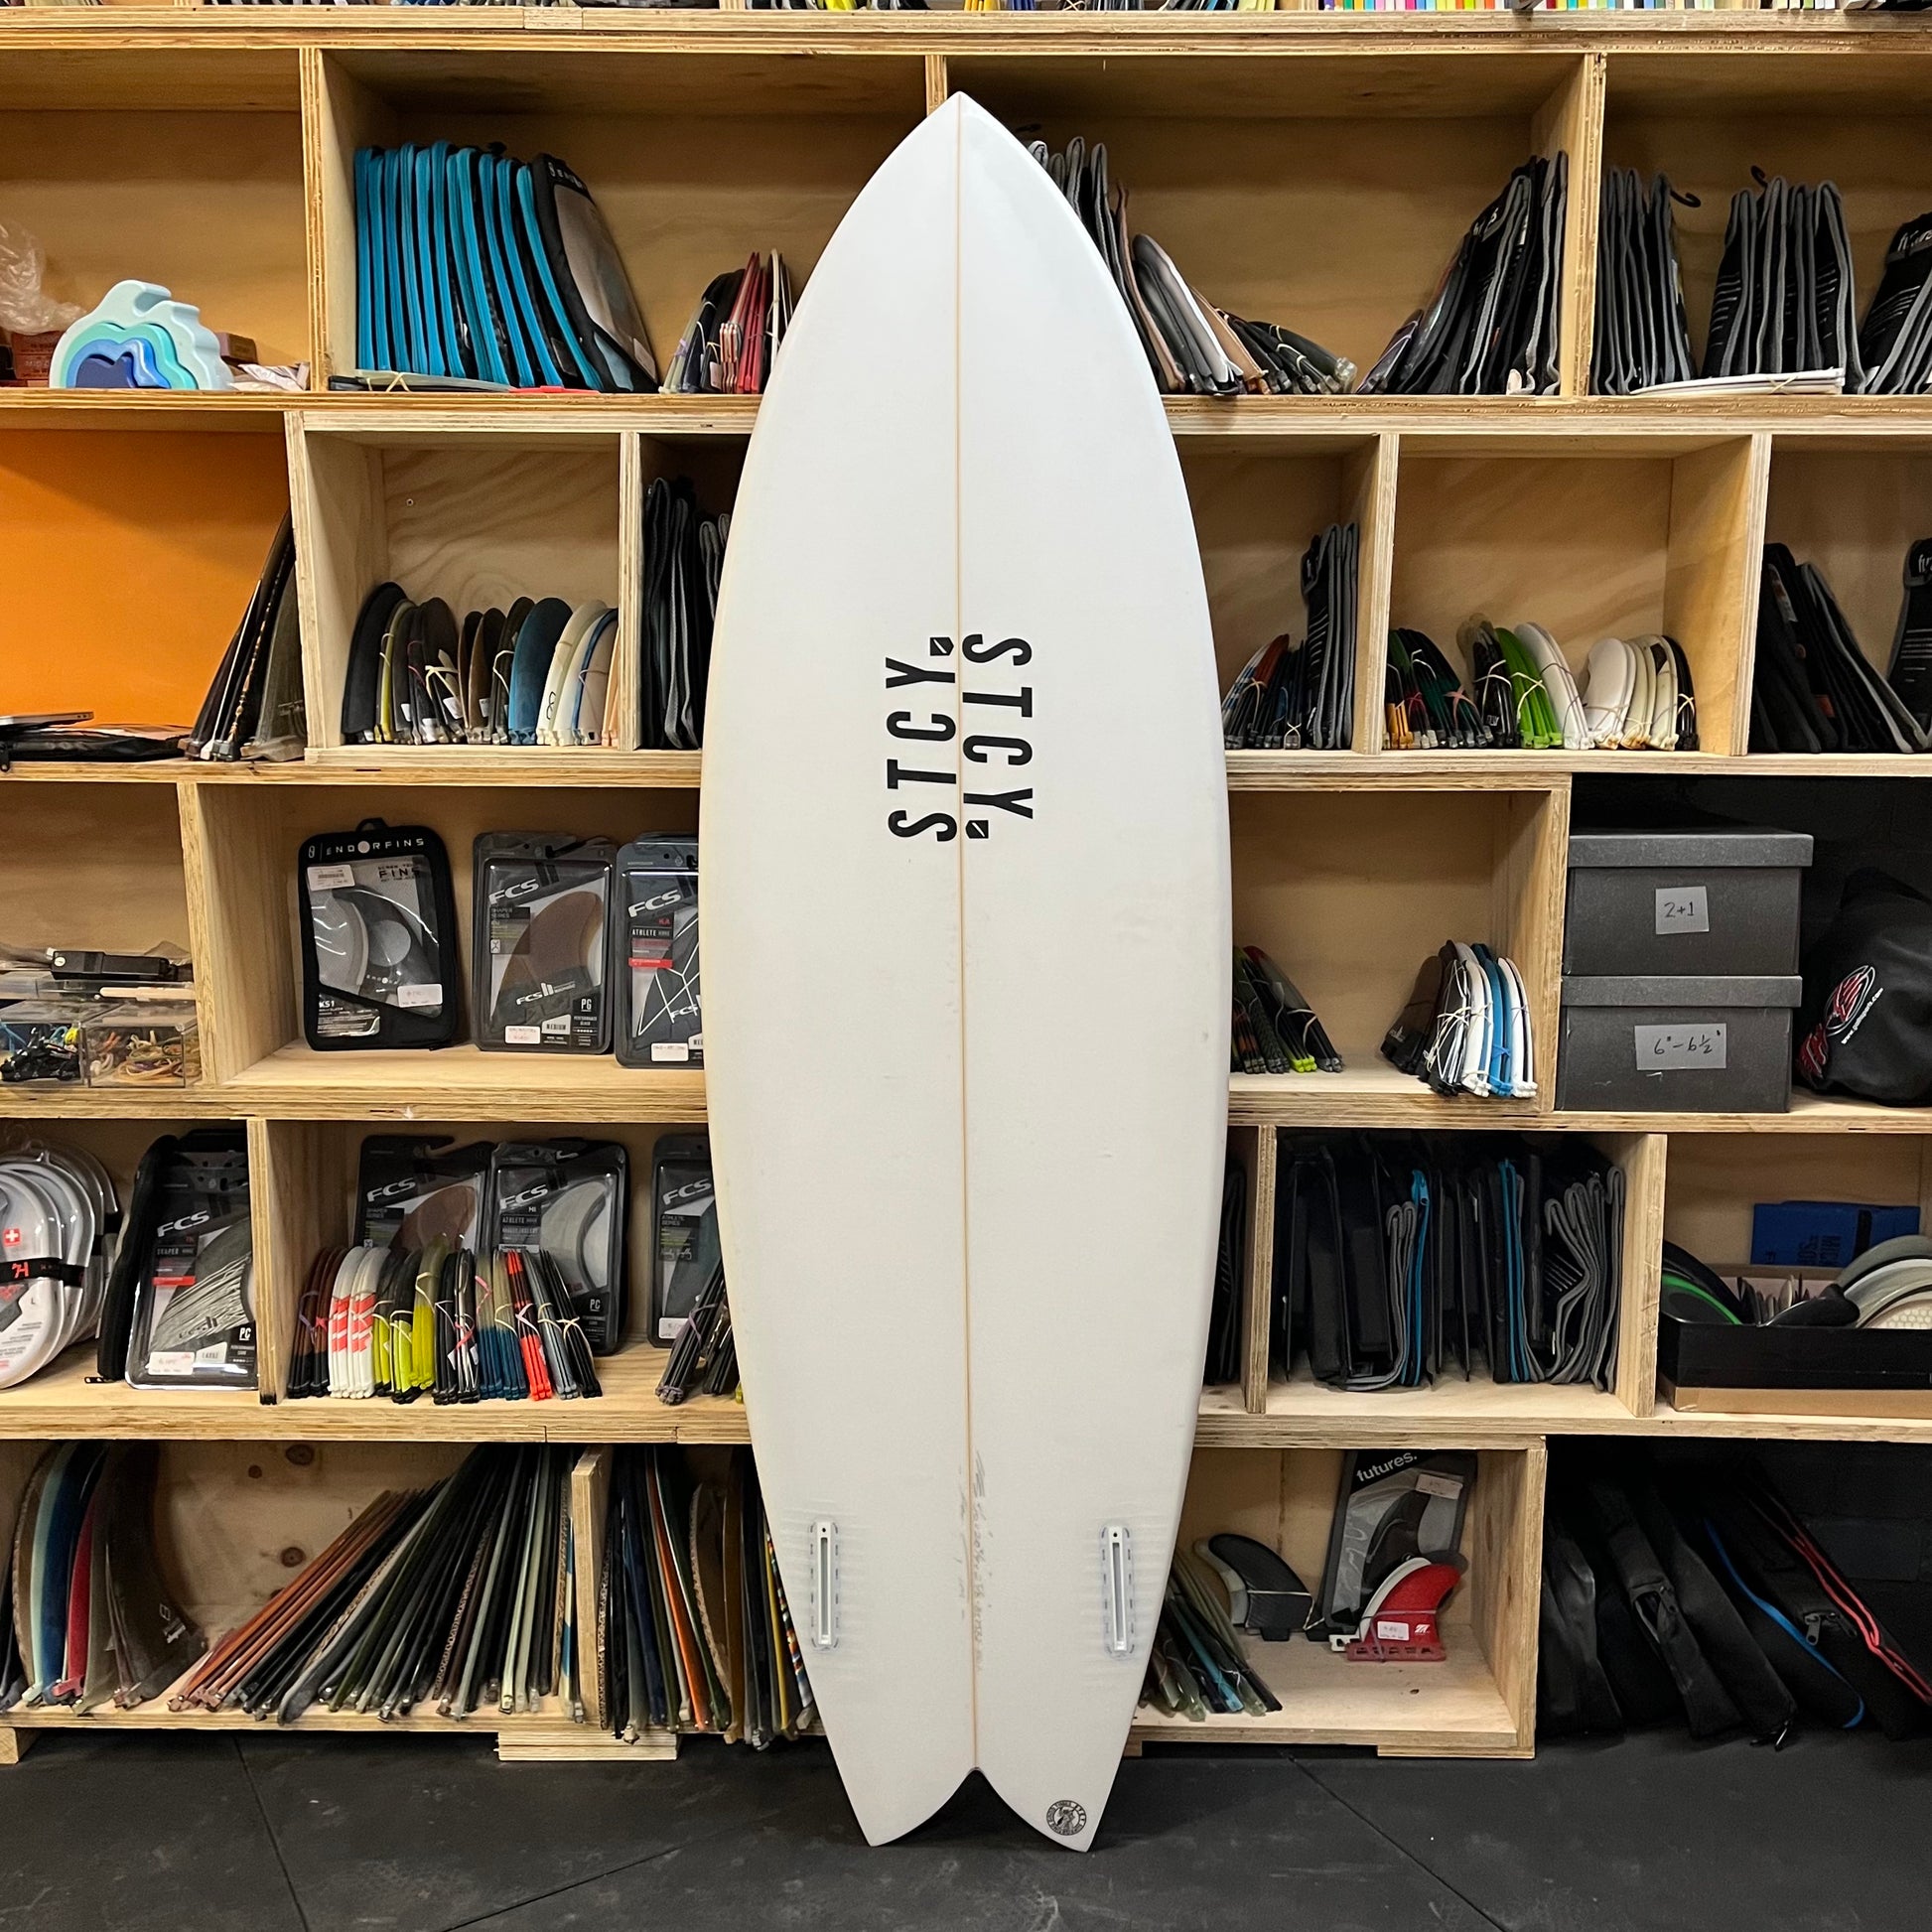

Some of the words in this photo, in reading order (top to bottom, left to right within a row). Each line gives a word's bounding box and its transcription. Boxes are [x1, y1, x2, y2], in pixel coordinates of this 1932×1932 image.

[488, 879, 539, 904] FCS
[627, 889, 681, 917] FCS
[1664, 900, 1695, 918] 2+1
[581, 998, 592, 1010] PG
[366, 1176, 416, 1202] FCS
[499, 1183, 548, 1209] FCS
[662, 1177, 712, 1205] FCS
[157, 1210, 209, 1237] FCS
[590, 1299, 601, 1310] PC
[239, 1327, 251, 1339] PC
[1356, 1452, 1418, 1481] futures.
